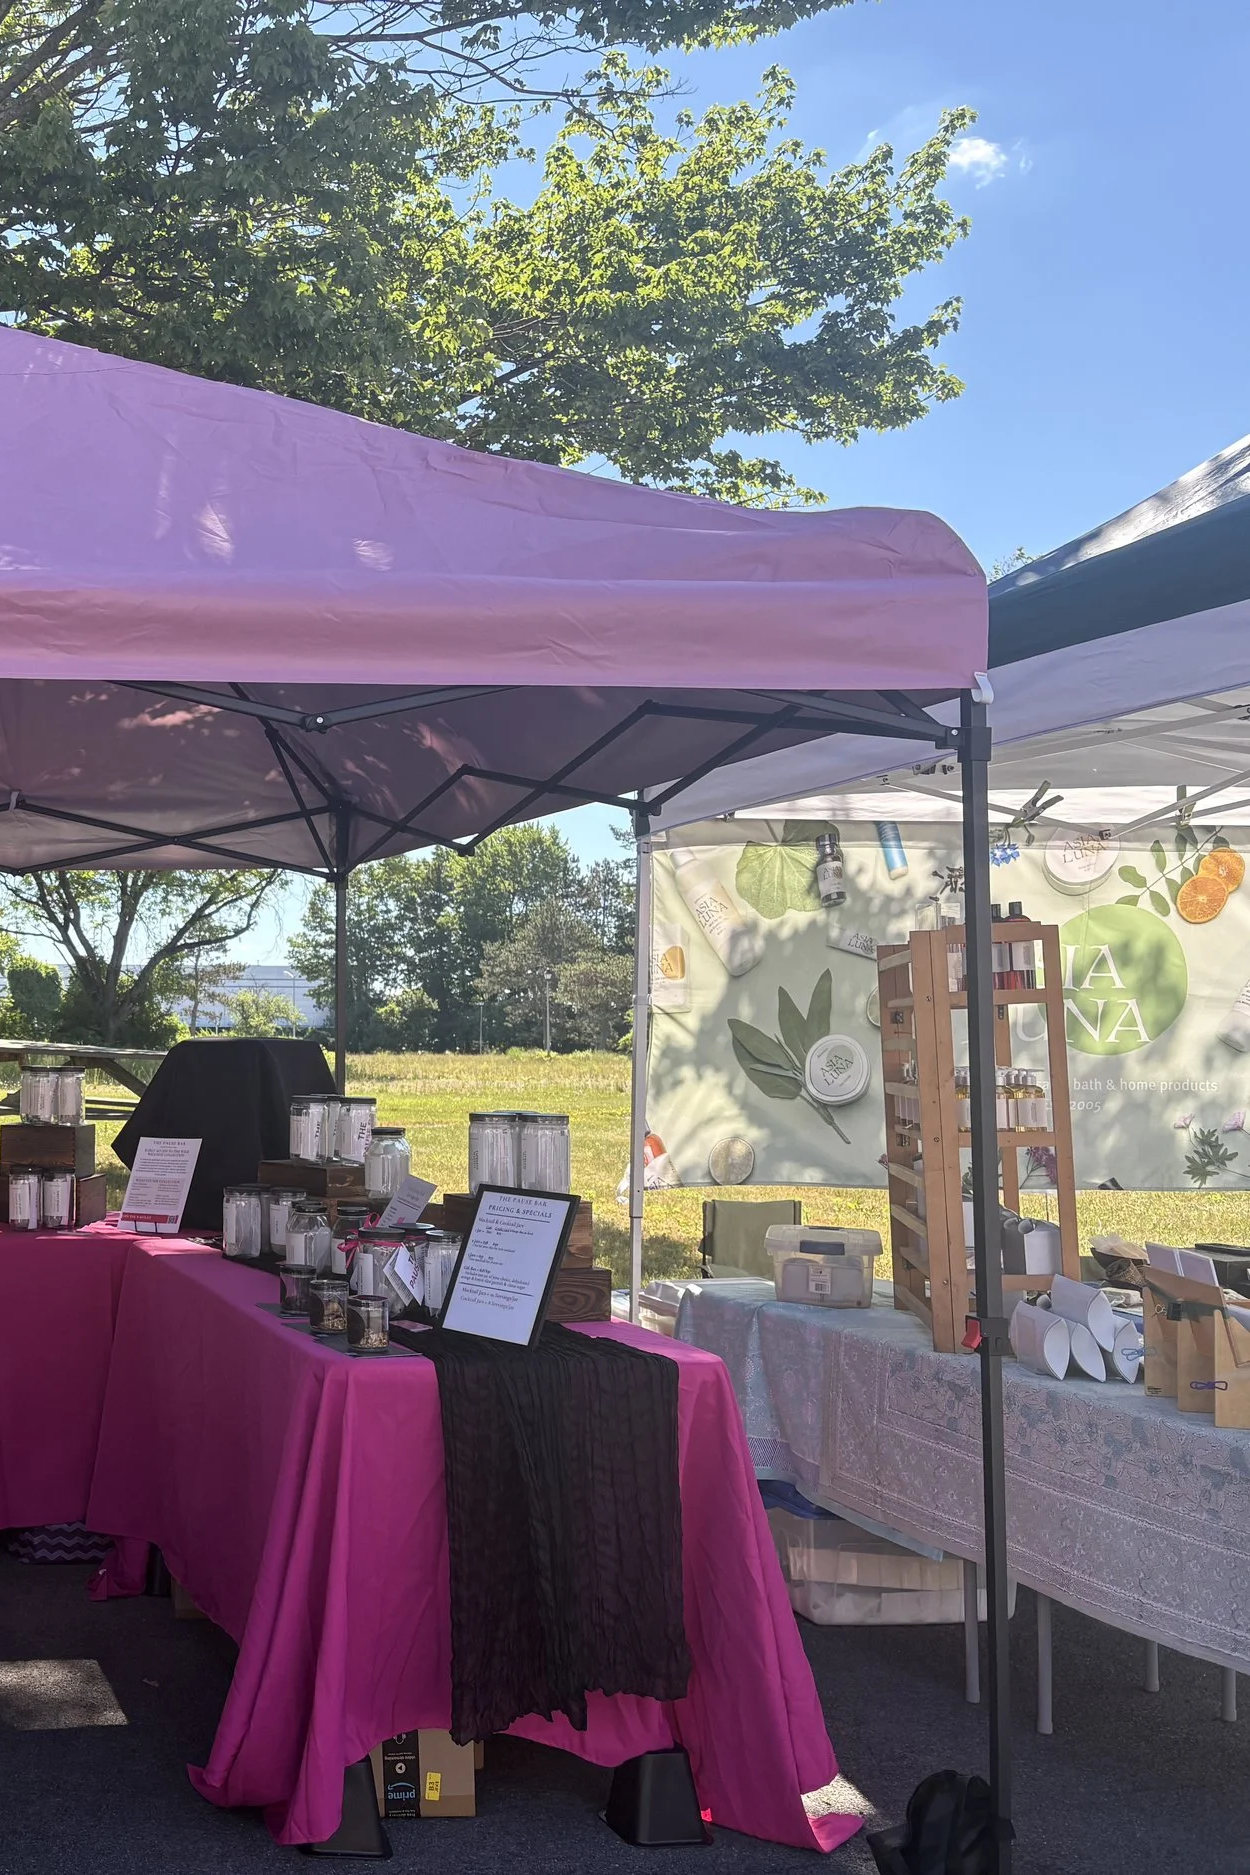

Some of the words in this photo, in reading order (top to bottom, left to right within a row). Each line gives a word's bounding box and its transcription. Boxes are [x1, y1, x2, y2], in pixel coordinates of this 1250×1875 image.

[1064, 835, 1097, 852] ASIA
[1063, 843, 1107, 864] LUNA
[696, 897, 718, 918] ASIA
[699, 902, 728, 928] LUNA
[821, 1055, 843, 1077] ASIA
[824, 1059, 853, 1085] LUNA
[1073, 1078, 1101, 1091] bath
[1106, 1079, 1116, 1090] &
[1120, 1078, 1156, 1091] home
[1160, 1079, 1218, 1093] products
[1069, 1101, 1101, 1113] 2005
[358, 1122, 367, 1140] THE
[512, 1197, 533, 1205] PAUSE
[488, 1204, 514, 1212] PRICING
[521, 1209, 552, 1218] SPECIALS
[388, 1789, 416, 1801] prime
